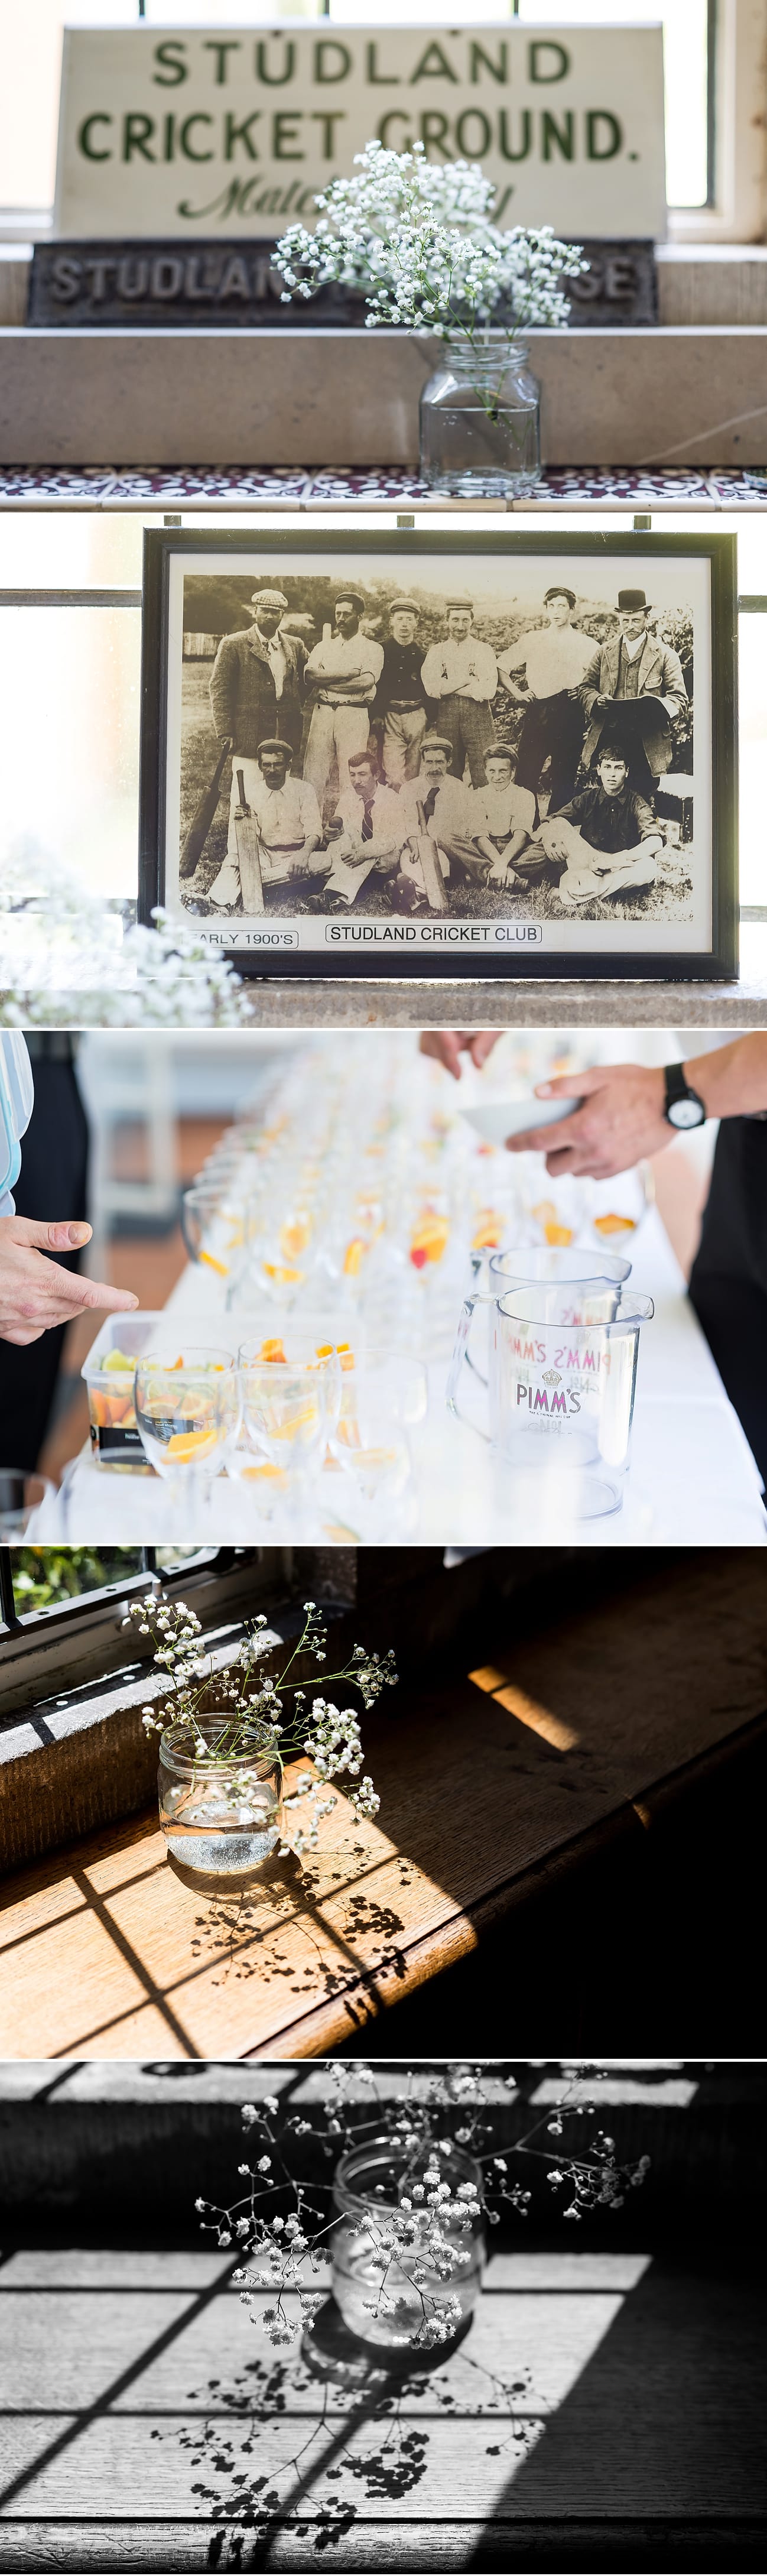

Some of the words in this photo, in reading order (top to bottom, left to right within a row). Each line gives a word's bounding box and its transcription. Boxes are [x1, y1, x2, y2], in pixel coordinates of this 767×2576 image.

[151, 39, 571, 88] STUDLAND
[76, 110, 346, 164] CRICKET
[376, 108, 639, 163] GROUND.
[245, 934, 294, 945] 1900'S
[330, 926, 416, 940] STUDLAND
[421, 927, 490, 941] CRICKET
[495, 927, 537, 941] CLUB
[516, 1383, 581, 1414] PIMM'S
